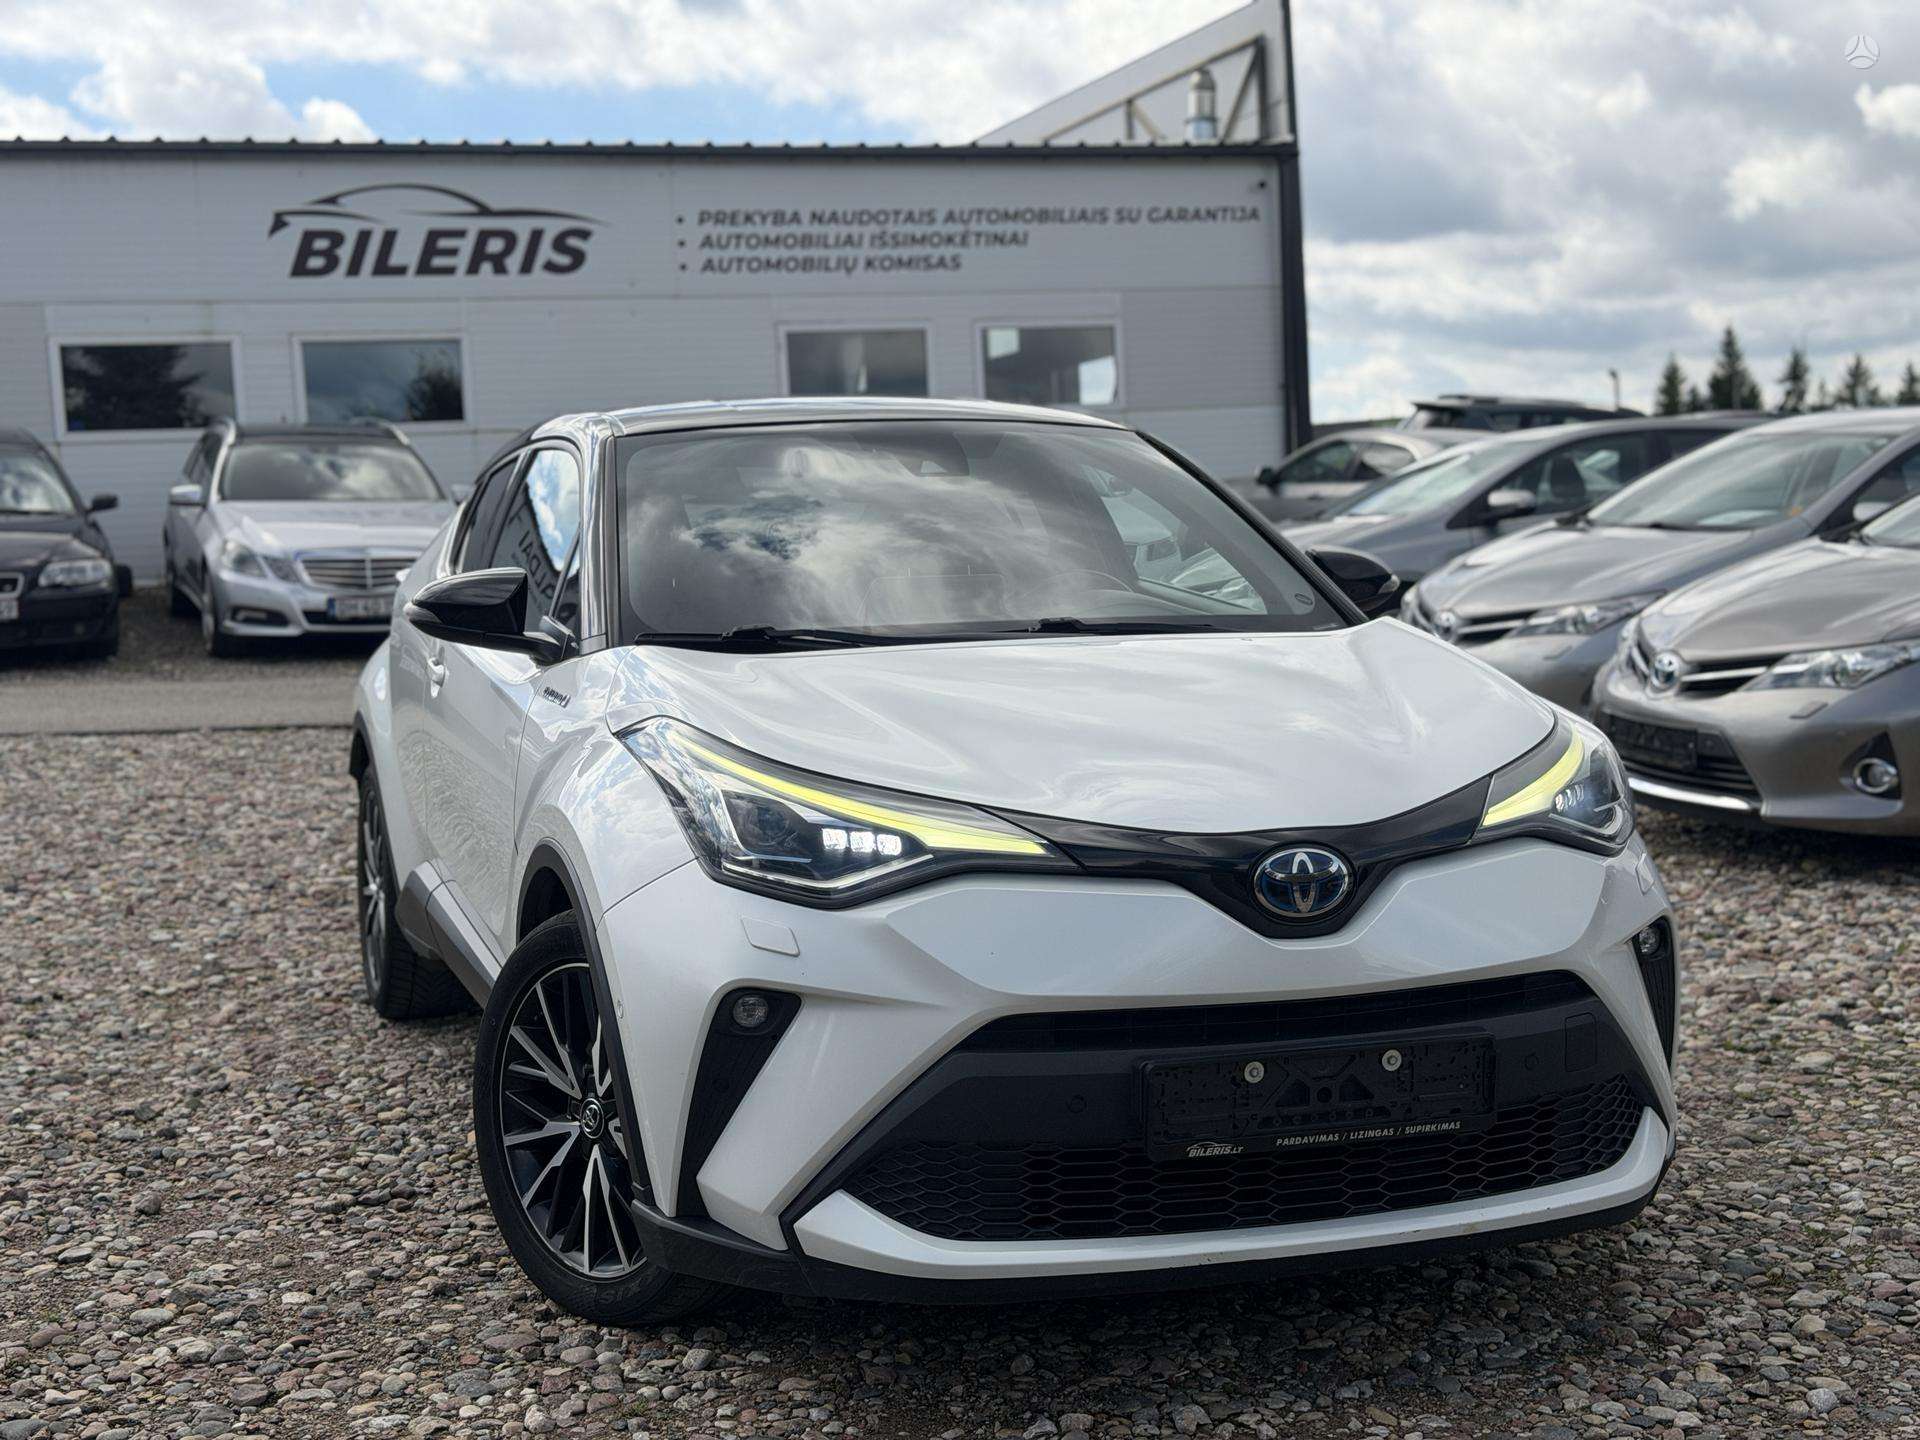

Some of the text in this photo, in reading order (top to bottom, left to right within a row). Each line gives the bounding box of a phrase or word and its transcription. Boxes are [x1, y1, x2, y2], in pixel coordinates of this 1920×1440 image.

[698, 206, 1260, 226] PREKYBA NAUDOTAIS AUTOMOBILIAIS SU GARANTIJA
[700, 232, 863, 251] AUTOMOBILIAI
[290, 228, 592, 277] BILERIS
[701, 255, 963, 277] AUTOMOBILIŲ KOMISAS
[1276, 1134, 1340, 1147] PARDAVIMAS
[1350, 1128, 1394, 1140] LIZINGAS
[1405, 1121, 1461, 1134] SUPIRKIMAS
[1188, 1145, 1244, 1158] BILERIS.LT
